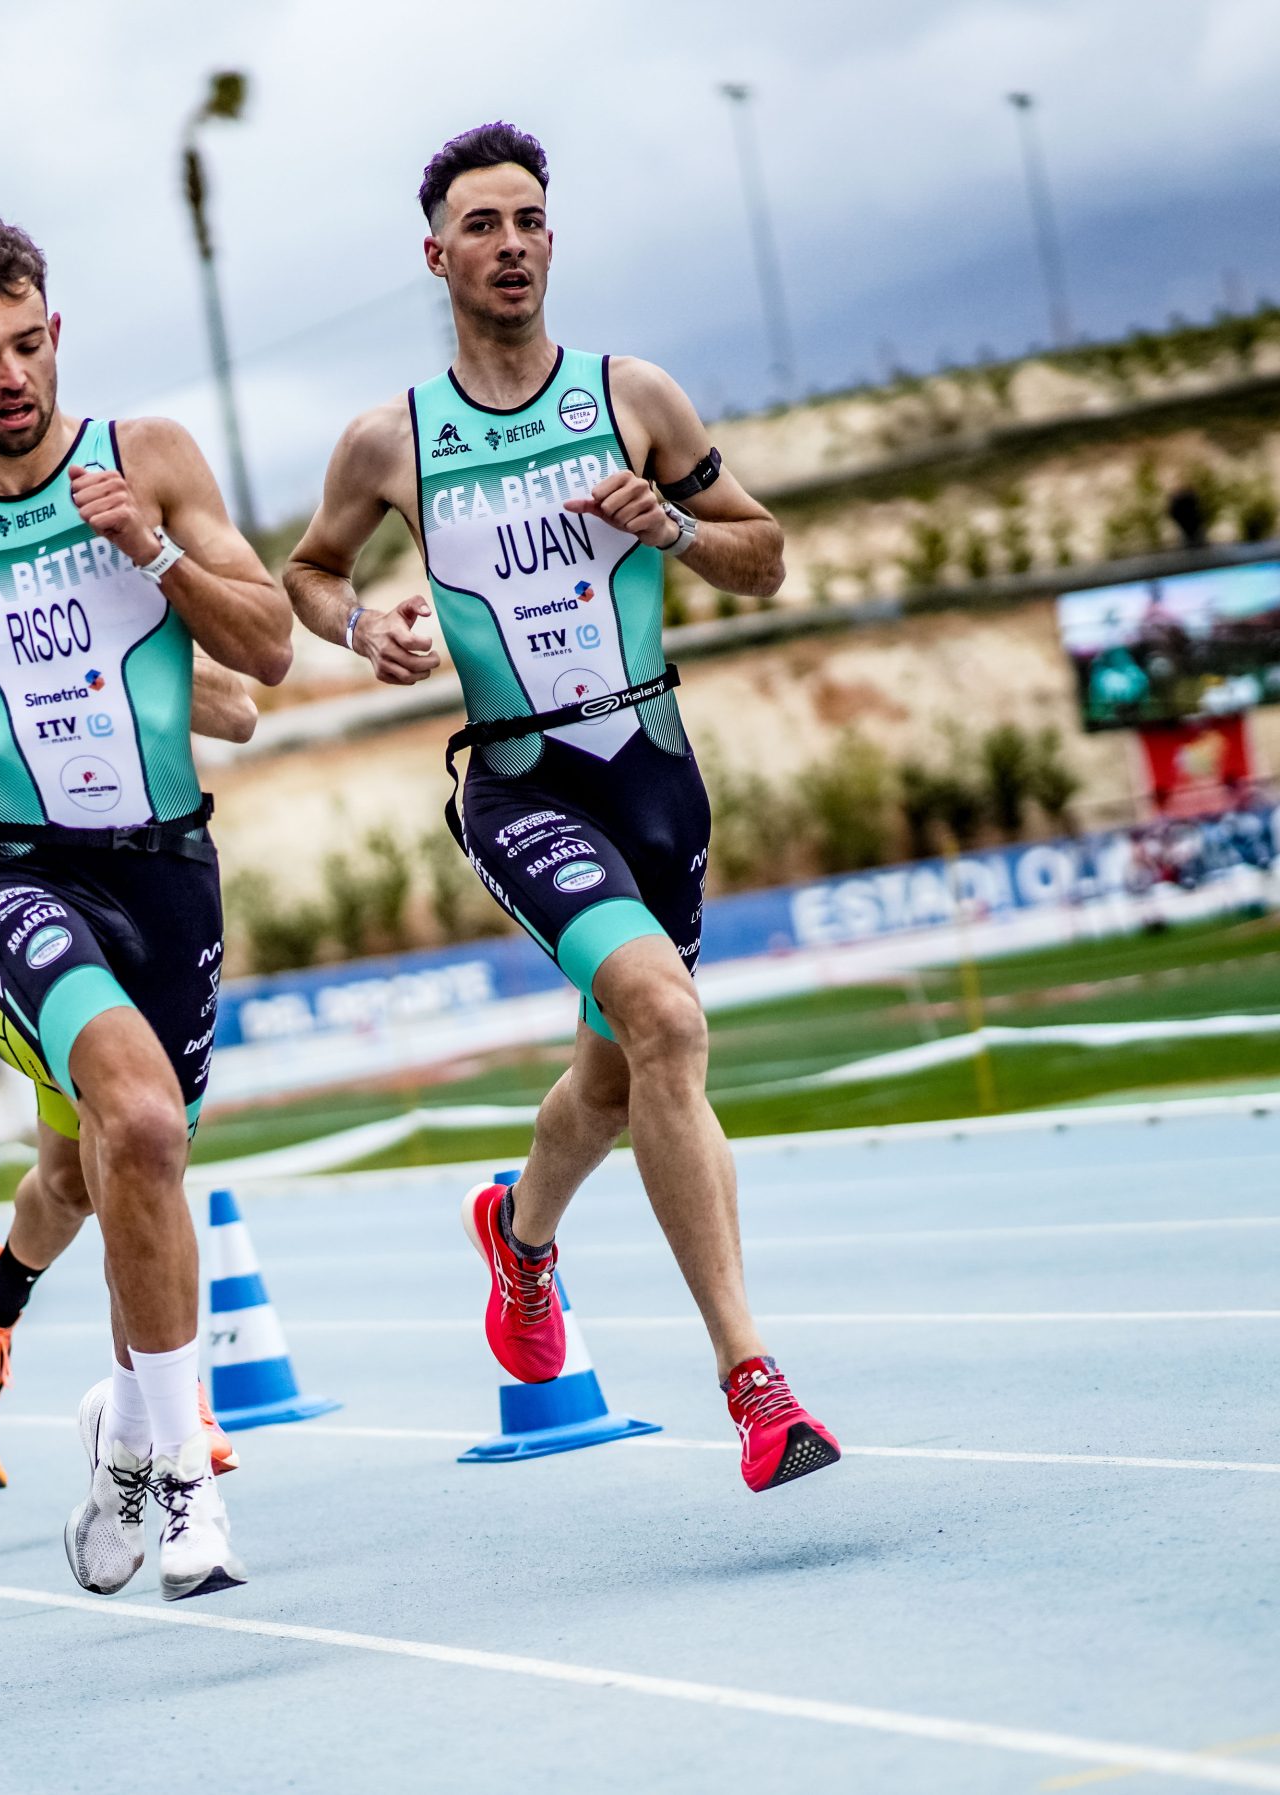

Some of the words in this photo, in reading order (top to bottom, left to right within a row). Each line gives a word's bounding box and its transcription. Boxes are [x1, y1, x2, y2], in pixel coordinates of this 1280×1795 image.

[506, 419, 546, 443] BÉTERA
[16, 502, 57, 529] BÉTERA
[432, 480, 495, 528] CEA
[494, 511, 596, 580] JUAN
[513, 597, 579, 621] Simetría
[6, 598, 92, 665] RISCO
[527, 628, 566, 652] ITV
[622, 680, 665, 704] Kalenji
[35, 716, 77, 739] ITV
[526, 843, 590, 877] SOLARTE
